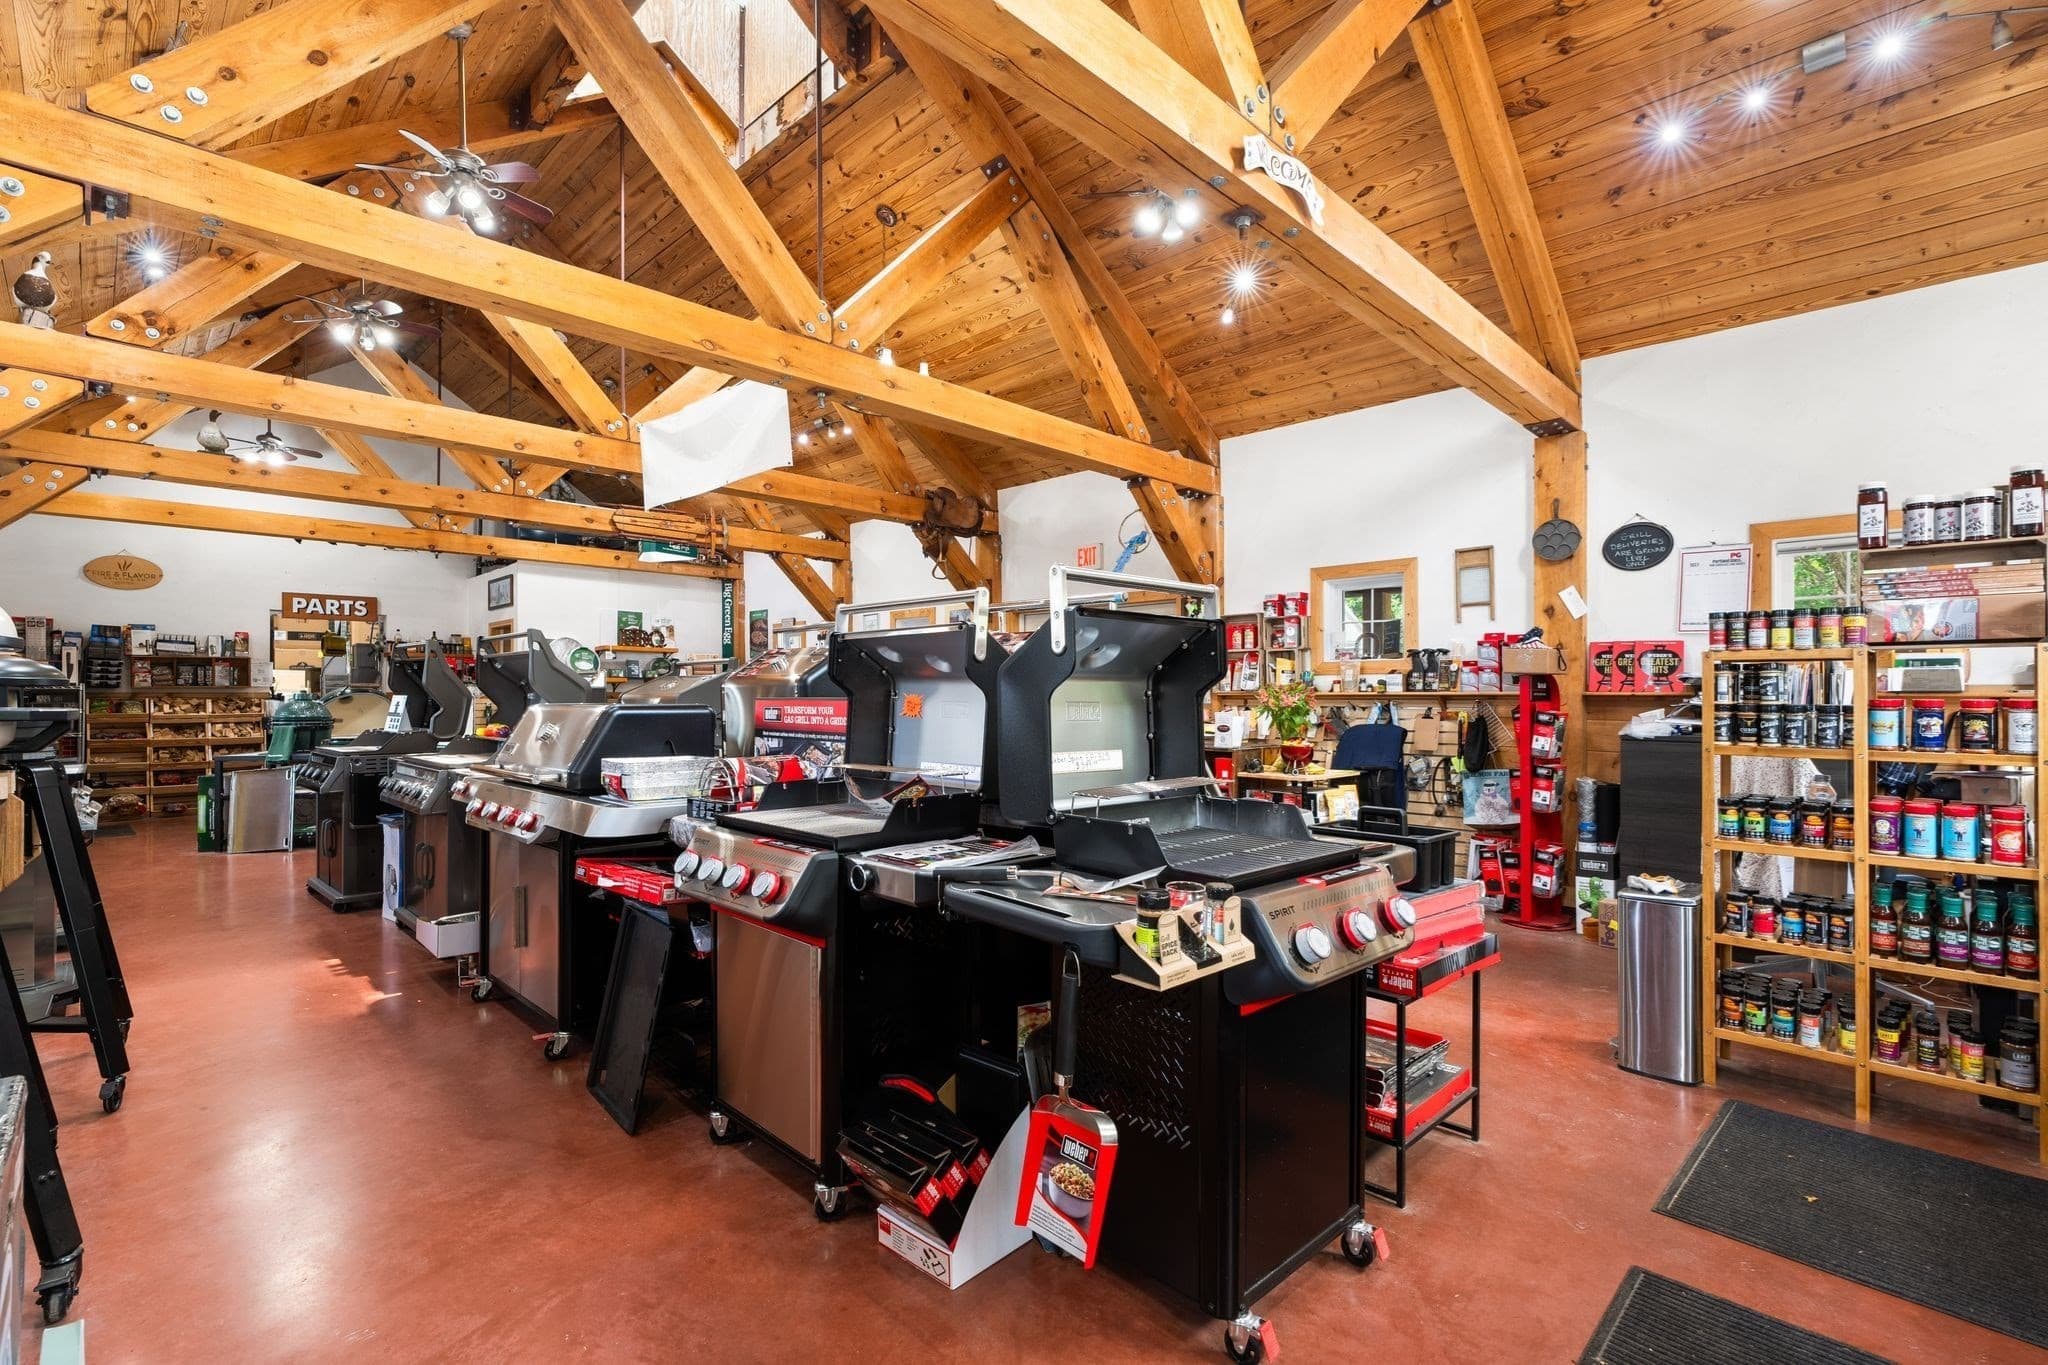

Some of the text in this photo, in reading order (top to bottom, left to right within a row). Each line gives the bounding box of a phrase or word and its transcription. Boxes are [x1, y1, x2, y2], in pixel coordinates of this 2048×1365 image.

[1620, 531, 1652, 541] GRILL
[1610, 538, 1664, 550] DELIVERIES
[1077, 545, 1097, 567] EXIT
[122, 571, 156, 579] FLAVOR
[292, 597, 368, 617] PARTS
[723, 582, 733, 644] Big Green Egg
[1641, 657, 1679, 667] GREATEST
[1650, 666, 1669, 674] HITS
[784, 706, 834, 715] TRANSFORM YOUR
[784, 716, 794, 724] GAS
[795, 716, 810, 725] GRILL
[810, 717, 824, 725] INTO
[824, 717, 829, 725] A
[1268, 905, 1296, 920] SPIRIT
[1161, 940, 1178, 951] SPICE
[1162, 948, 1179, 957] RACK
[1381, 968, 1414, 979] CRAFTED
[1388, 975, 1413, 990] weber
[1063, 1138, 1089, 1162] weber
